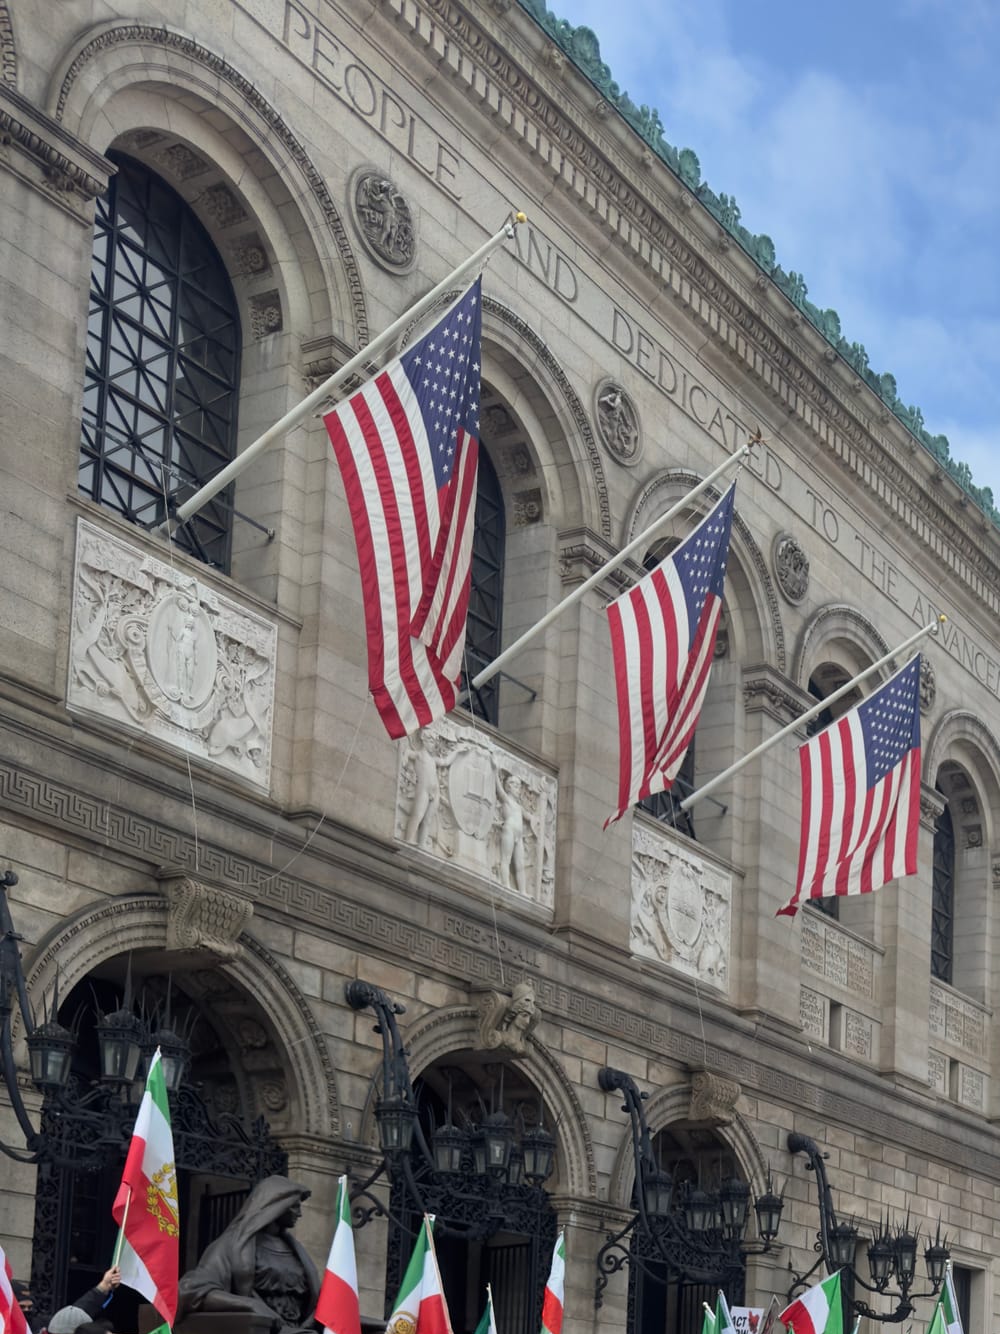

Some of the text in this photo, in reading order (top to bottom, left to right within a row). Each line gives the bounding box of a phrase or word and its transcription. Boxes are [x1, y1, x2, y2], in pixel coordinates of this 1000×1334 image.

[283, 2, 462, 201] PEOPLE
[499, 211, 579, 303] AND
[612, 308, 782, 490] DEDICATED
[808, 490, 840, 543] TO
[855, 535, 899, 603] THE
